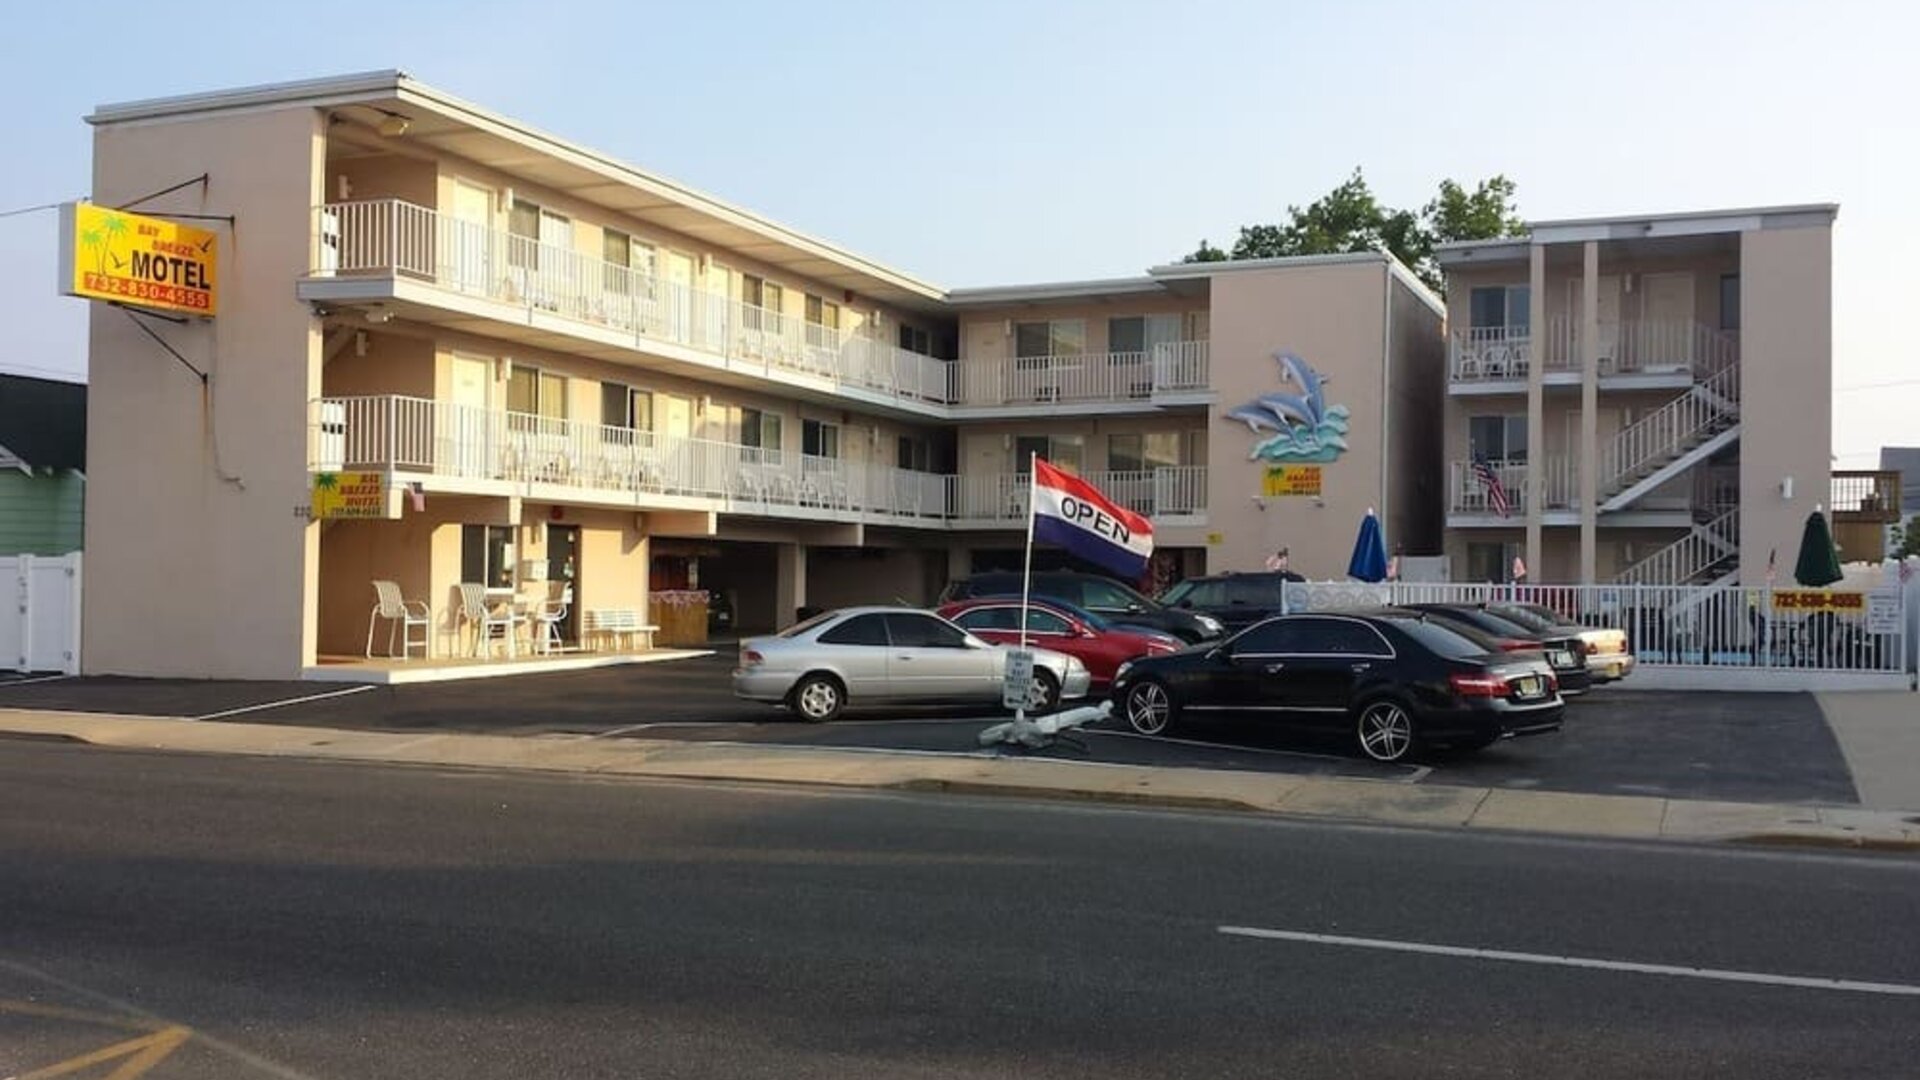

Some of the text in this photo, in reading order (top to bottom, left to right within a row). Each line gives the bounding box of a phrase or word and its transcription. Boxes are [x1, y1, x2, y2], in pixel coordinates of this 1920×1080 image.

[138, 224, 160, 236] BAY
[132, 250, 211, 290] MOTEL
[90, 275, 206, 308] 732-830-4555
[1061, 497, 1130, 544] OPEN
